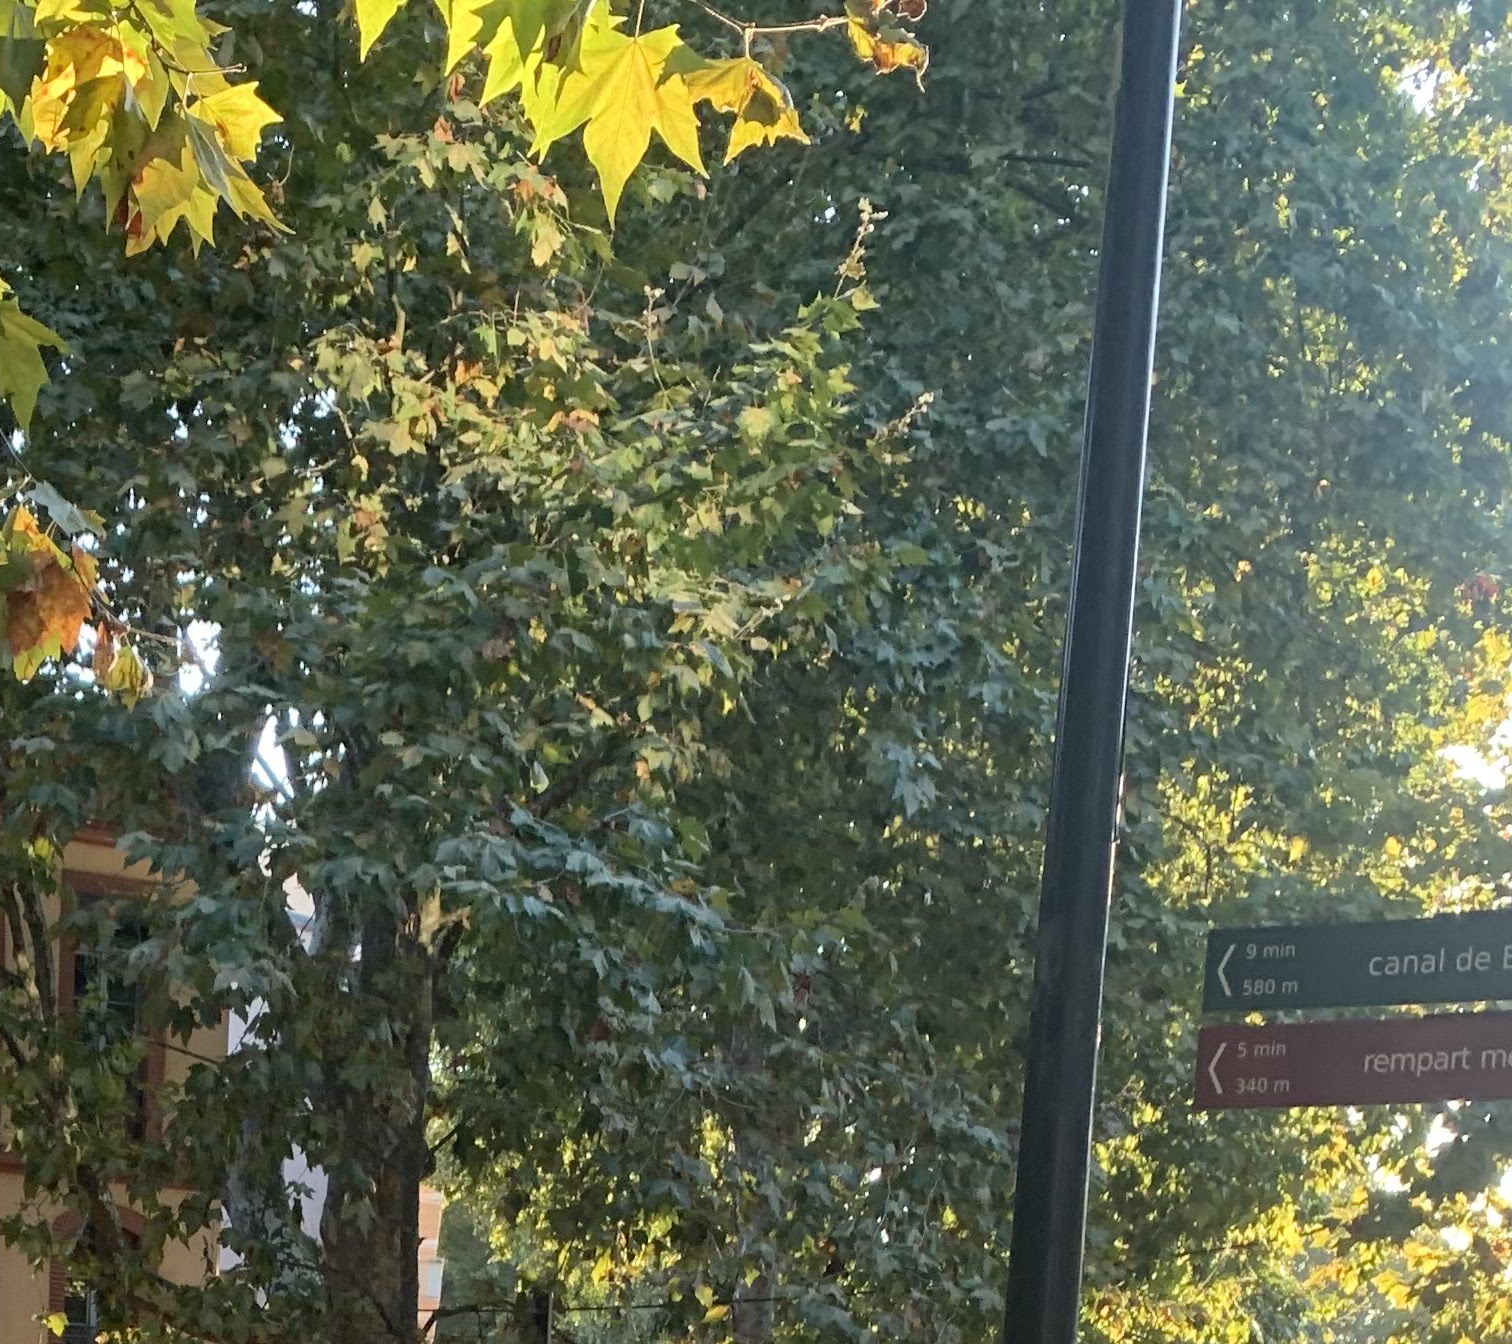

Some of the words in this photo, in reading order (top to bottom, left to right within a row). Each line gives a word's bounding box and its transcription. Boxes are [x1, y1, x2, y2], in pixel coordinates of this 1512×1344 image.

[1246, 943, 1257, 960] 9
[1263, 942, 1296, 958] min
[1369, 946, 1445, 976] canal
[1456, 944, 1491, 972] de
[1243, 978, 1276, 996] 580
[1281, 980, 1298, 994] m
[1236, 1042, 1247, 1058] 5
[1254, 1040, 1286, 1057] min
[1363, 1047, 1472, 1077] rempart
[1235, 1076, 1268, 1095] 340
[1273, 1078, 1290, 1092] m
